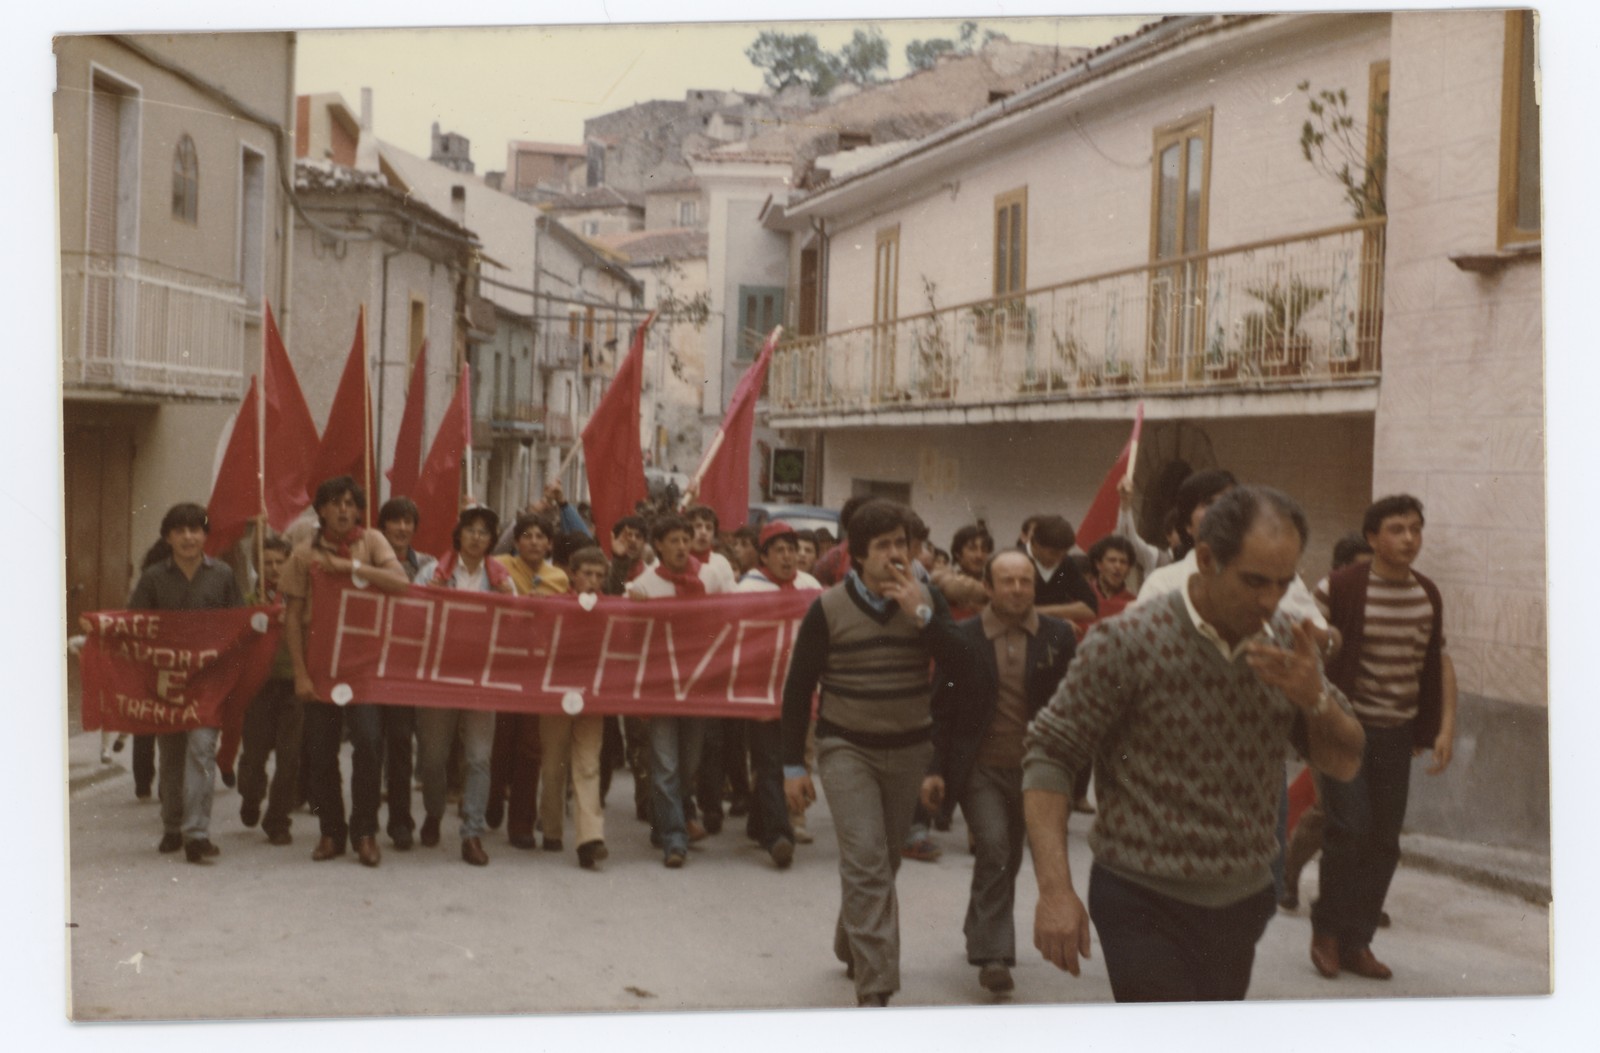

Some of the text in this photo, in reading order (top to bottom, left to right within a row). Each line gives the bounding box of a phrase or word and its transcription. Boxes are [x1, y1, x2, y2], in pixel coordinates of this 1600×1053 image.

[98, 613, 160, 639] PACE
[330, 589, 802, 704] PACE-LAVO
[157, 670, 187, 704] E
